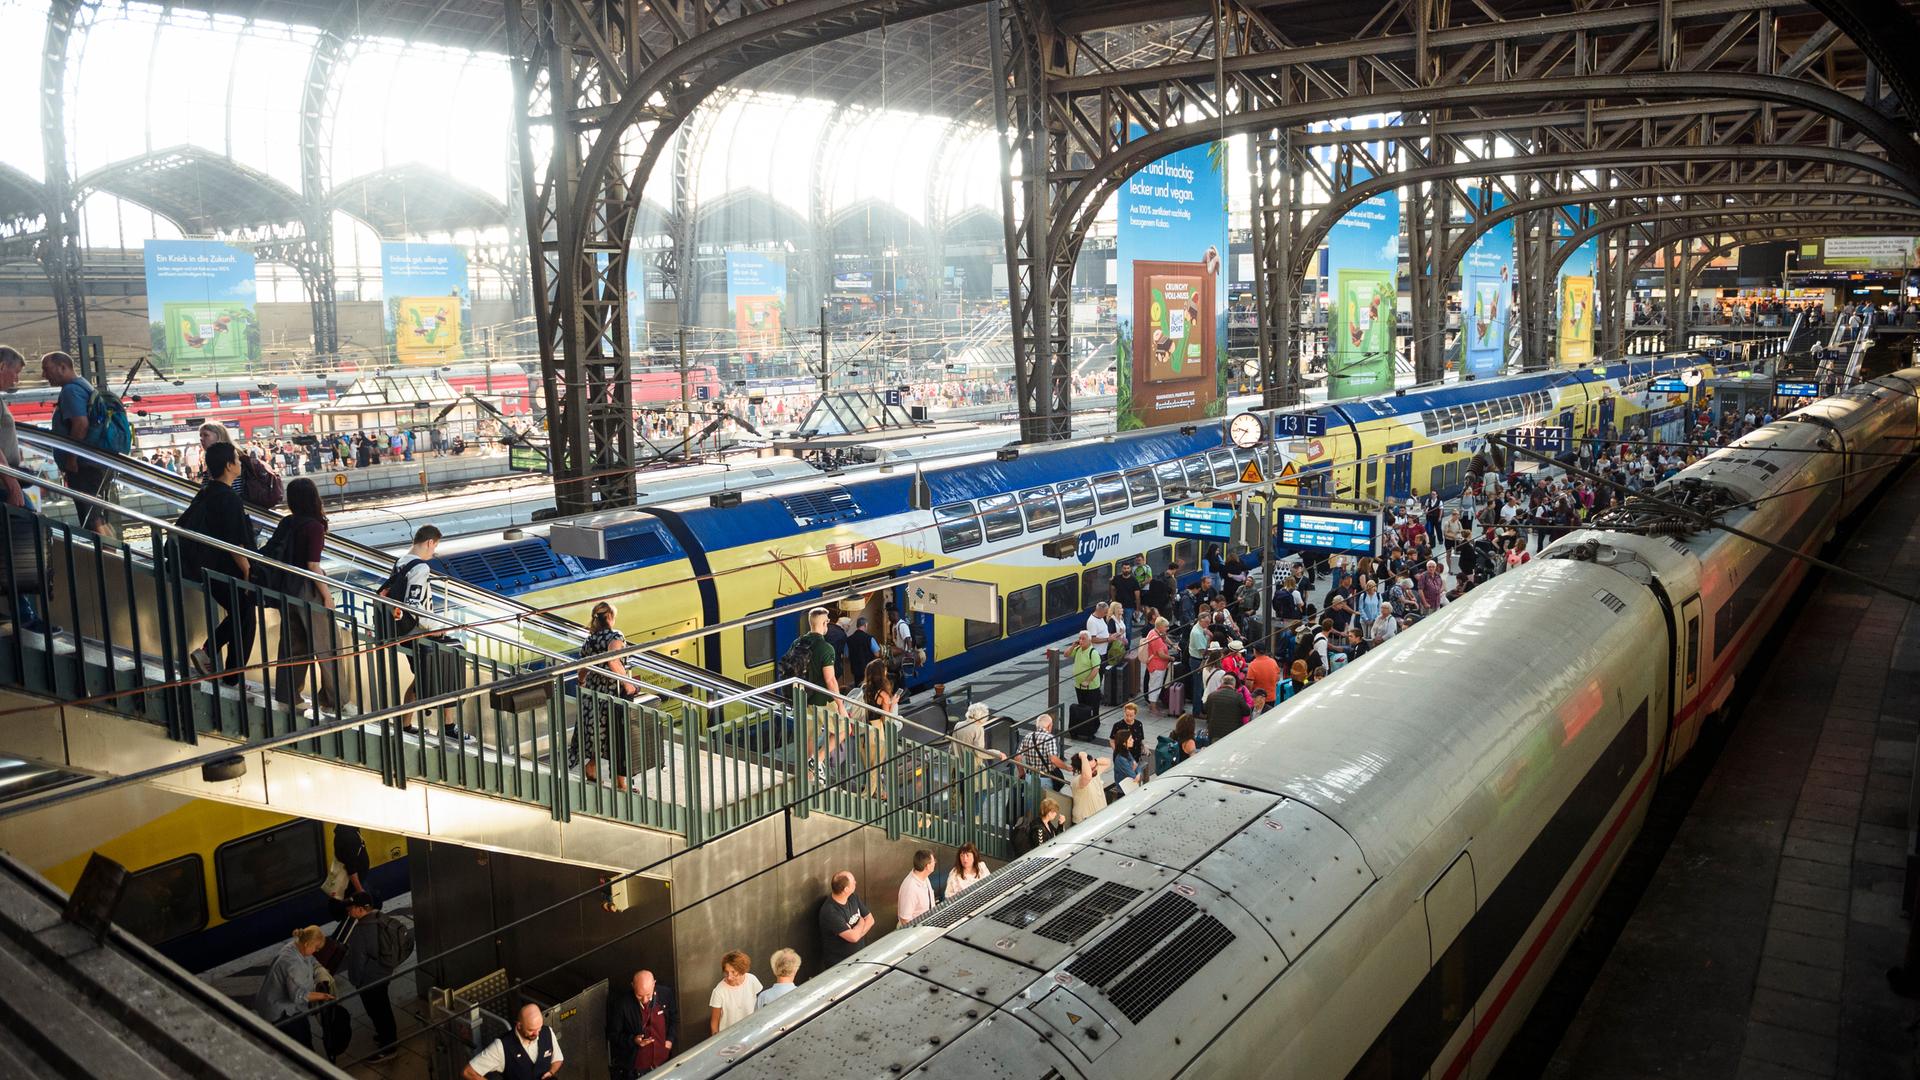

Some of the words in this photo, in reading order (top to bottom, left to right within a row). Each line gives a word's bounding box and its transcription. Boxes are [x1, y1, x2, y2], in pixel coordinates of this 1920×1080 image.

[1130, 177, 1153, 196] lecker
[1155, 182, 1169, 198] und
[1170, 187, 1194, 204] vegan.
[156, 254, 167, 263] Ein
[168, 254, 187, 263] Knick
[188, 254, 195, 263] in
[210, 254, 238, 264] Zukunft.
[890, 391, 898, 404] E
[1282, 416, 1297, 431] 13
[1307, 418, 1317, 433] E
[1516, 430, 1527, 447] E
[1540, 430, 1559, 446] 14
[1353, 520, 1364, 531] 14
[838, 547, 869, 564] RUHE
